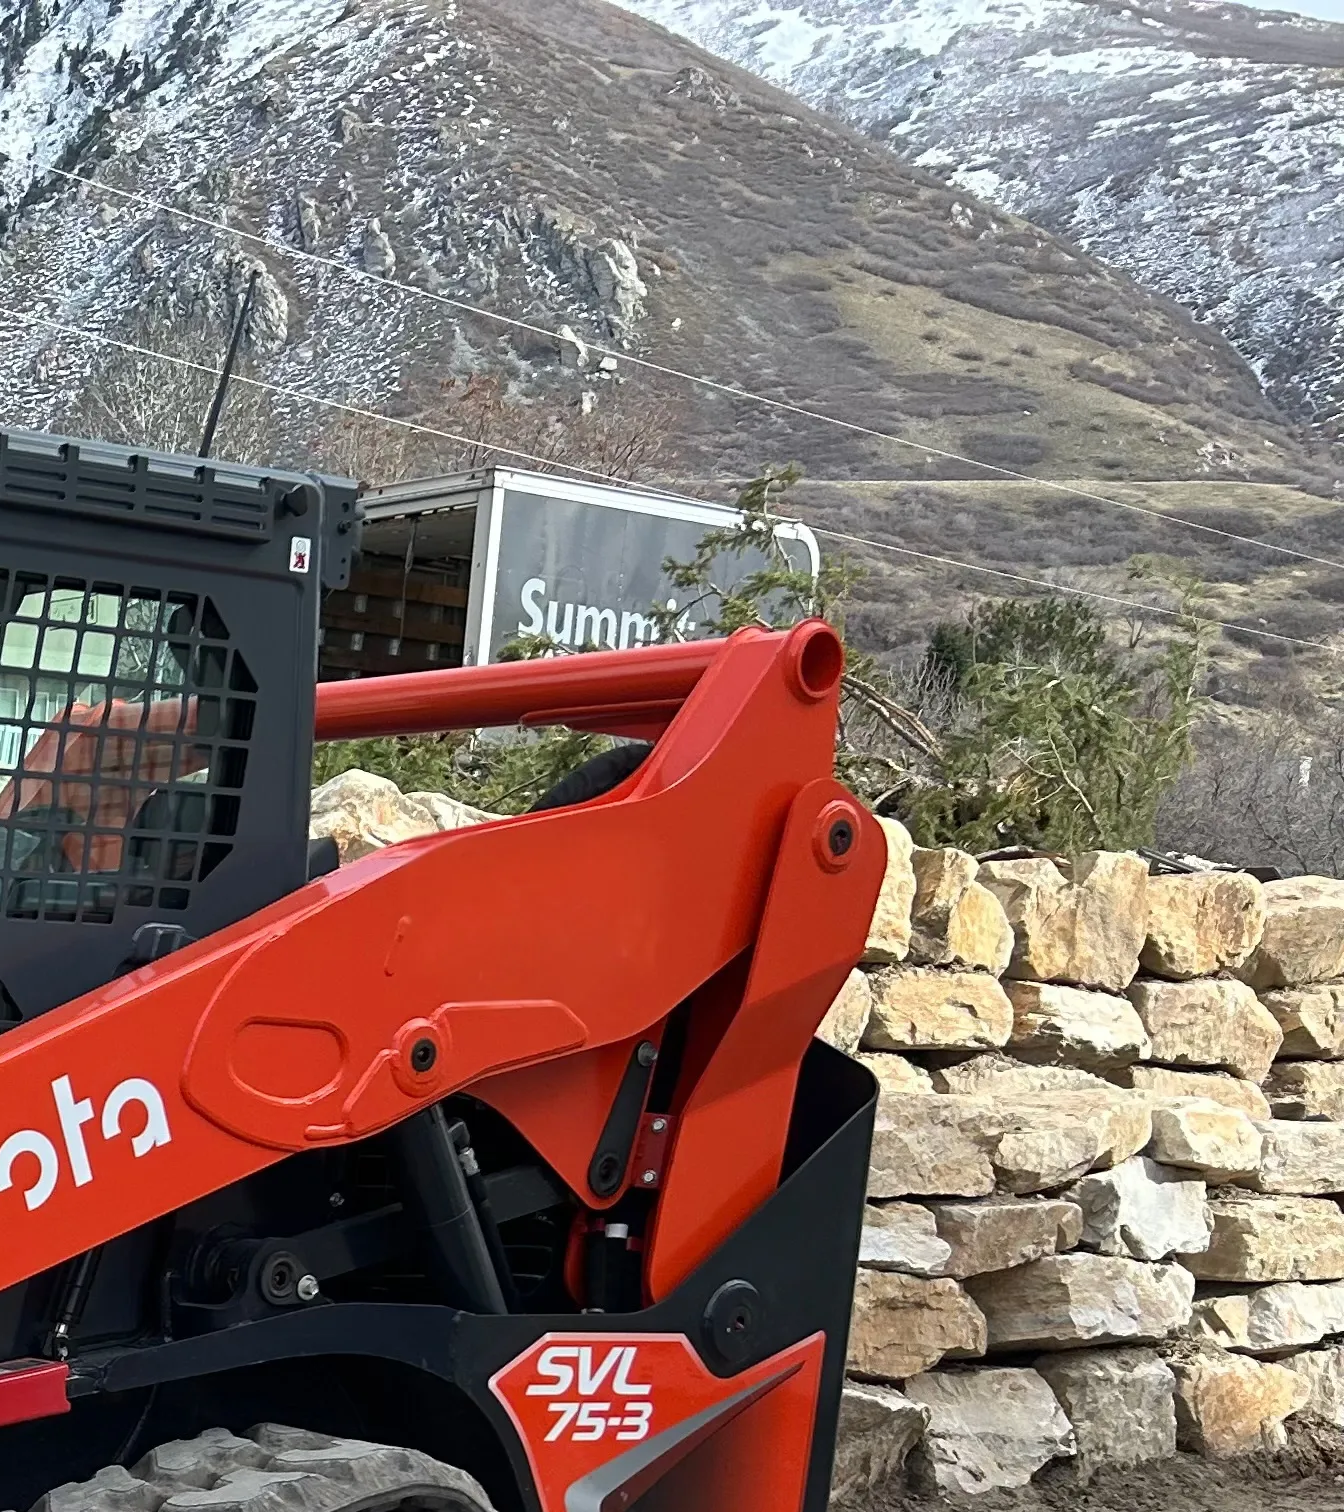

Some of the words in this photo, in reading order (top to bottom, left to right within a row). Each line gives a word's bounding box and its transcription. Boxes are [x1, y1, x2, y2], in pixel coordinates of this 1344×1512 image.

[517, 577, 697, 649] Summt
[525, 1346, 652, 1396] SVL
[543, 1402, 653, 1442] 75-3
